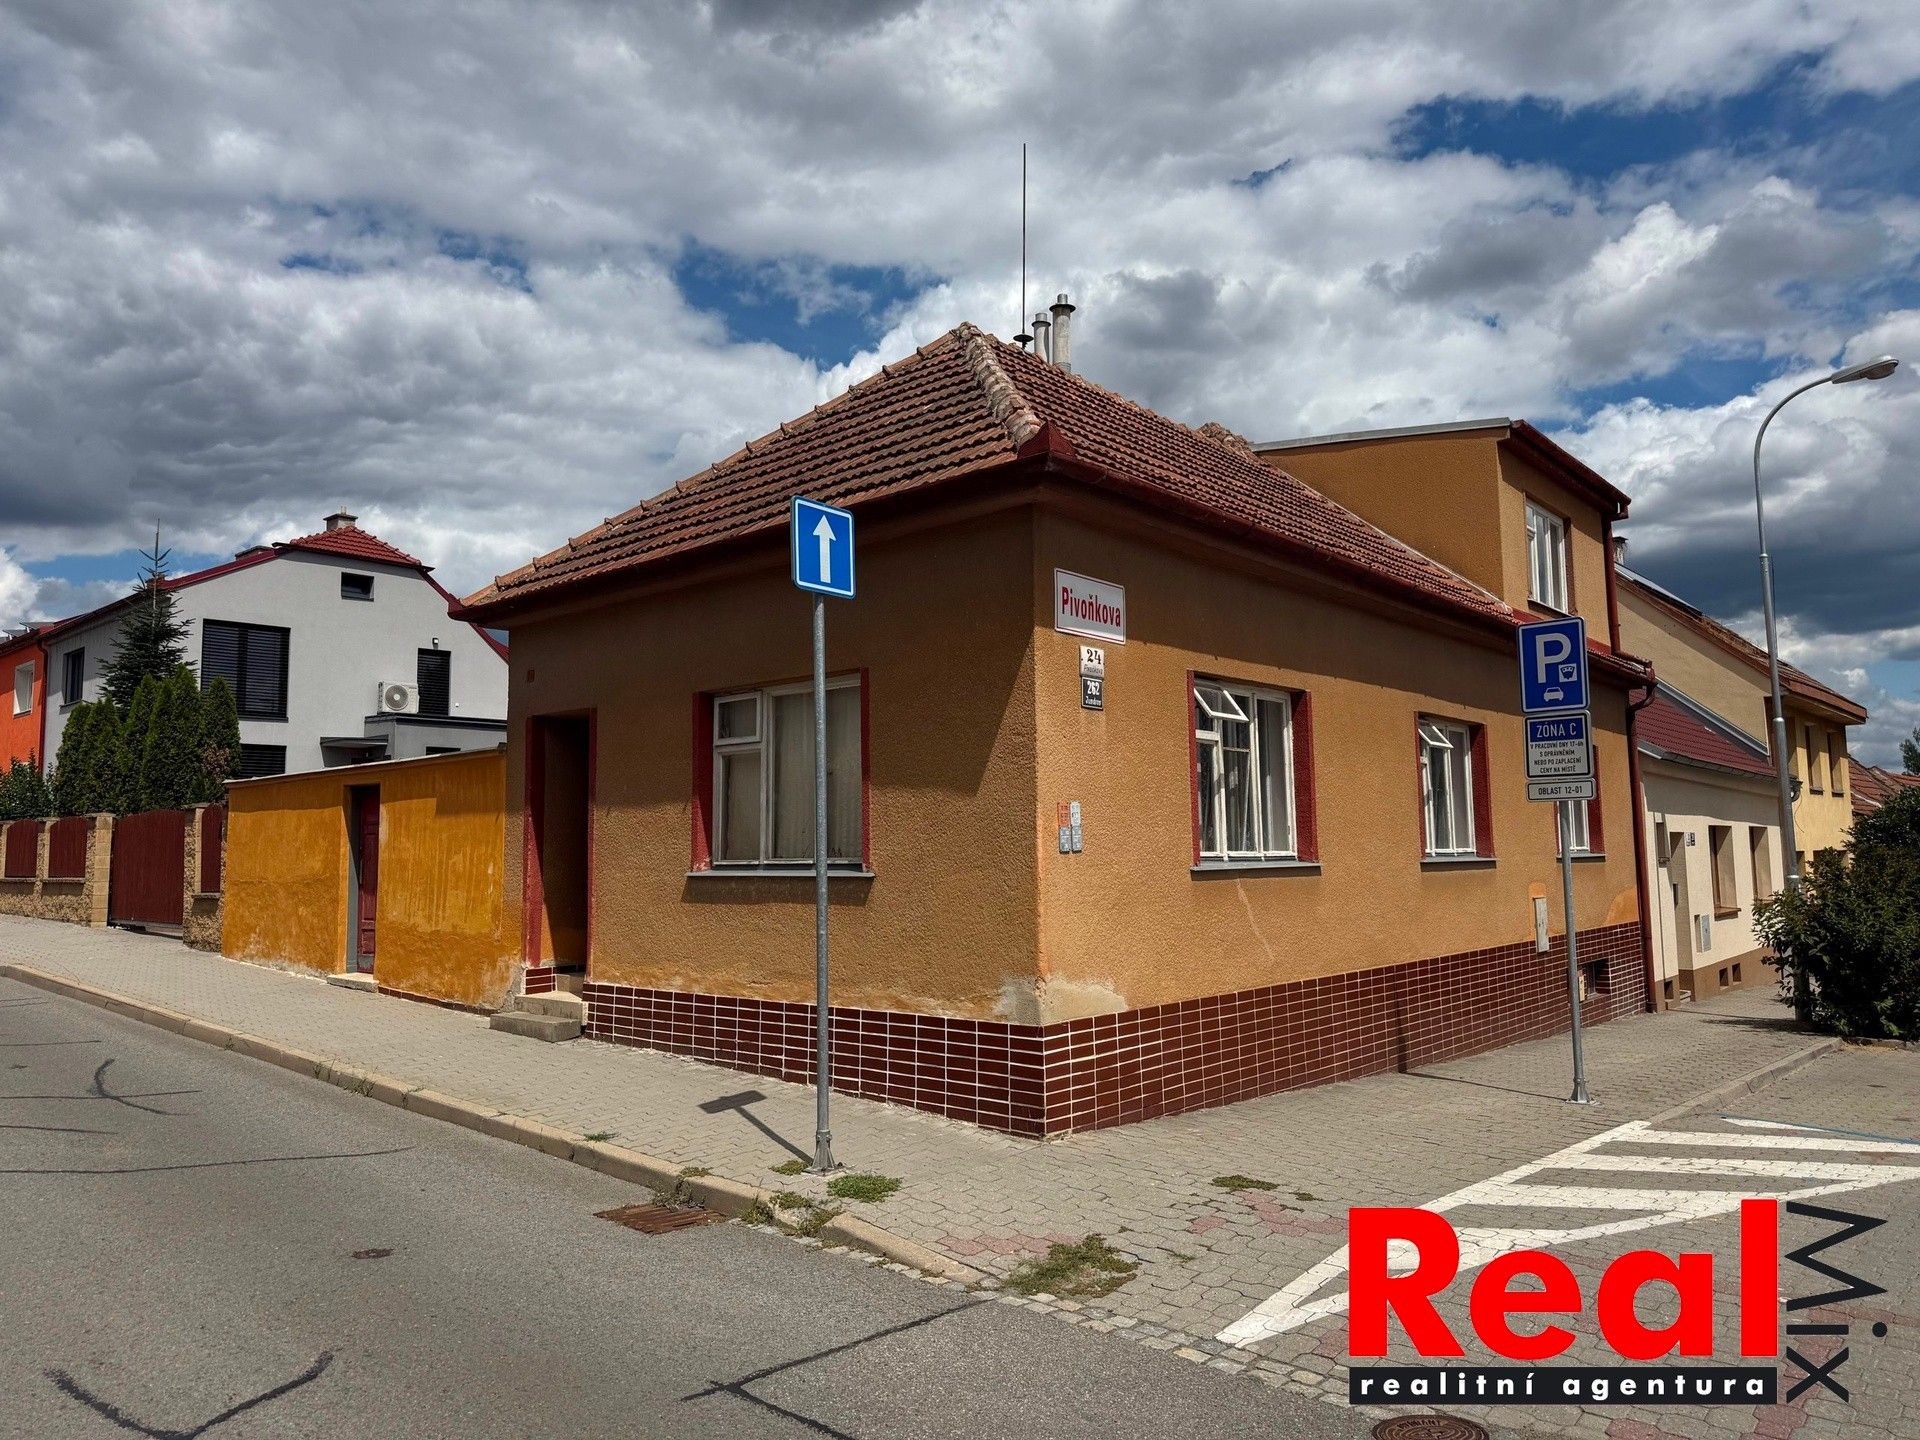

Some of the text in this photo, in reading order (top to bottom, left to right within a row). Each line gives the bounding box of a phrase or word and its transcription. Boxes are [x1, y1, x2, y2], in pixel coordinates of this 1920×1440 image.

[1062, 587, 1120, 627] Pivoňkova
[1087, 648, 1101, 665] 24
[1535, 632, 1572, 684] P
[1087, 680, 1100, 695] 262
[1536, 721, 1577, 738] ZÓNA C
[1535, 741, 1558, 749] PRACOVNÍ
[1544, 749, 1575, 757] OPRÁVNĚNÍM
[1555, 756, 1582, 765] ZAPLACENÍ
[1561, 765, 1576, 773] MÍSTĚ
[1538, 785, 1583, 795] OBLAST 12-01
